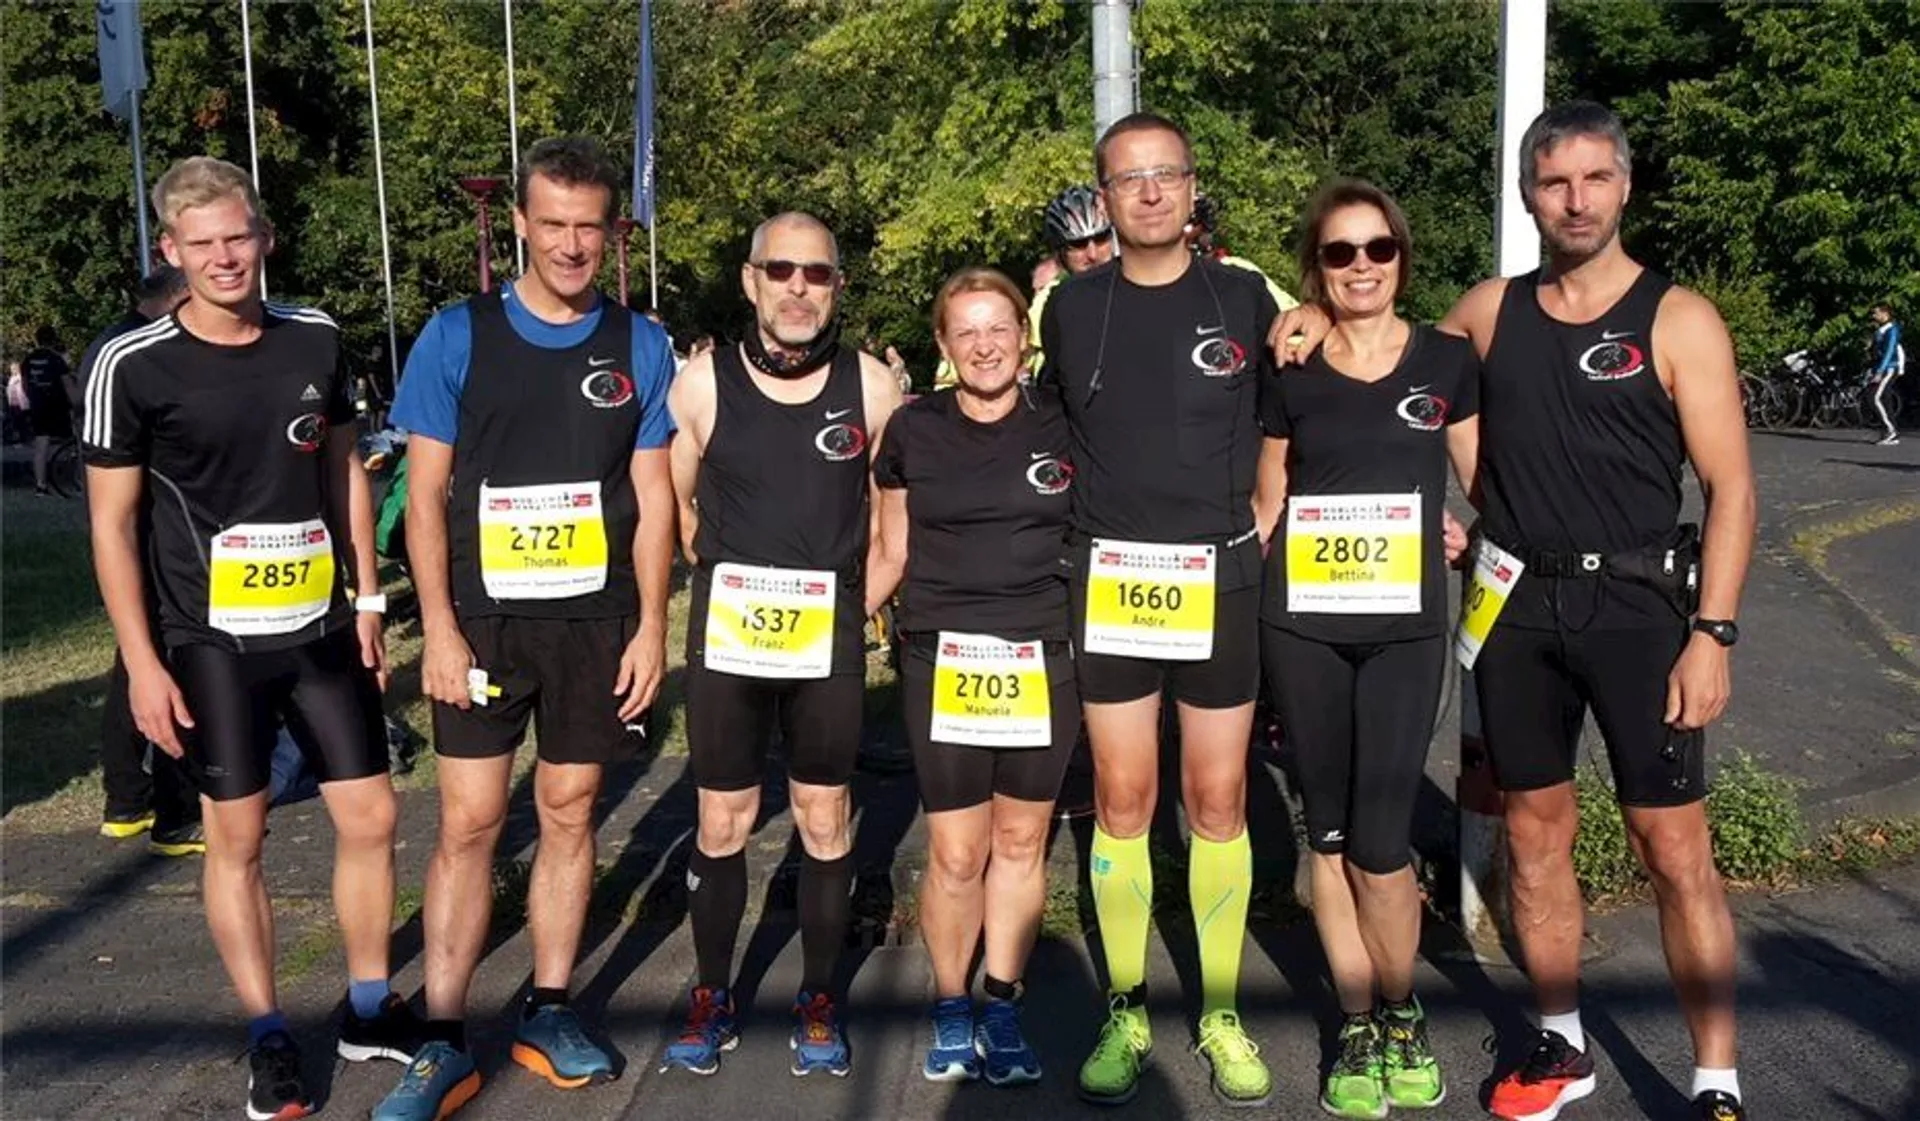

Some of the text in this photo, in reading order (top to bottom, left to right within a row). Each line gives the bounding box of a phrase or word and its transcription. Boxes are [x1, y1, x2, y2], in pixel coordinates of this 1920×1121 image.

[510, 524, 576, 551] 2727
[1315, 537, 1389, 563] 2802
[243, 560, 311, 588] 2857
[523, 555, 569, 569] Thomas
[1329, 568, 1376, 581] Bettina
[1118, 583, 1182, 611] 1660
[752, 636, 785, 650] Franz
[956, 672, 1020, 699] 2703
[965, 703, 1011, 716] Manuela
